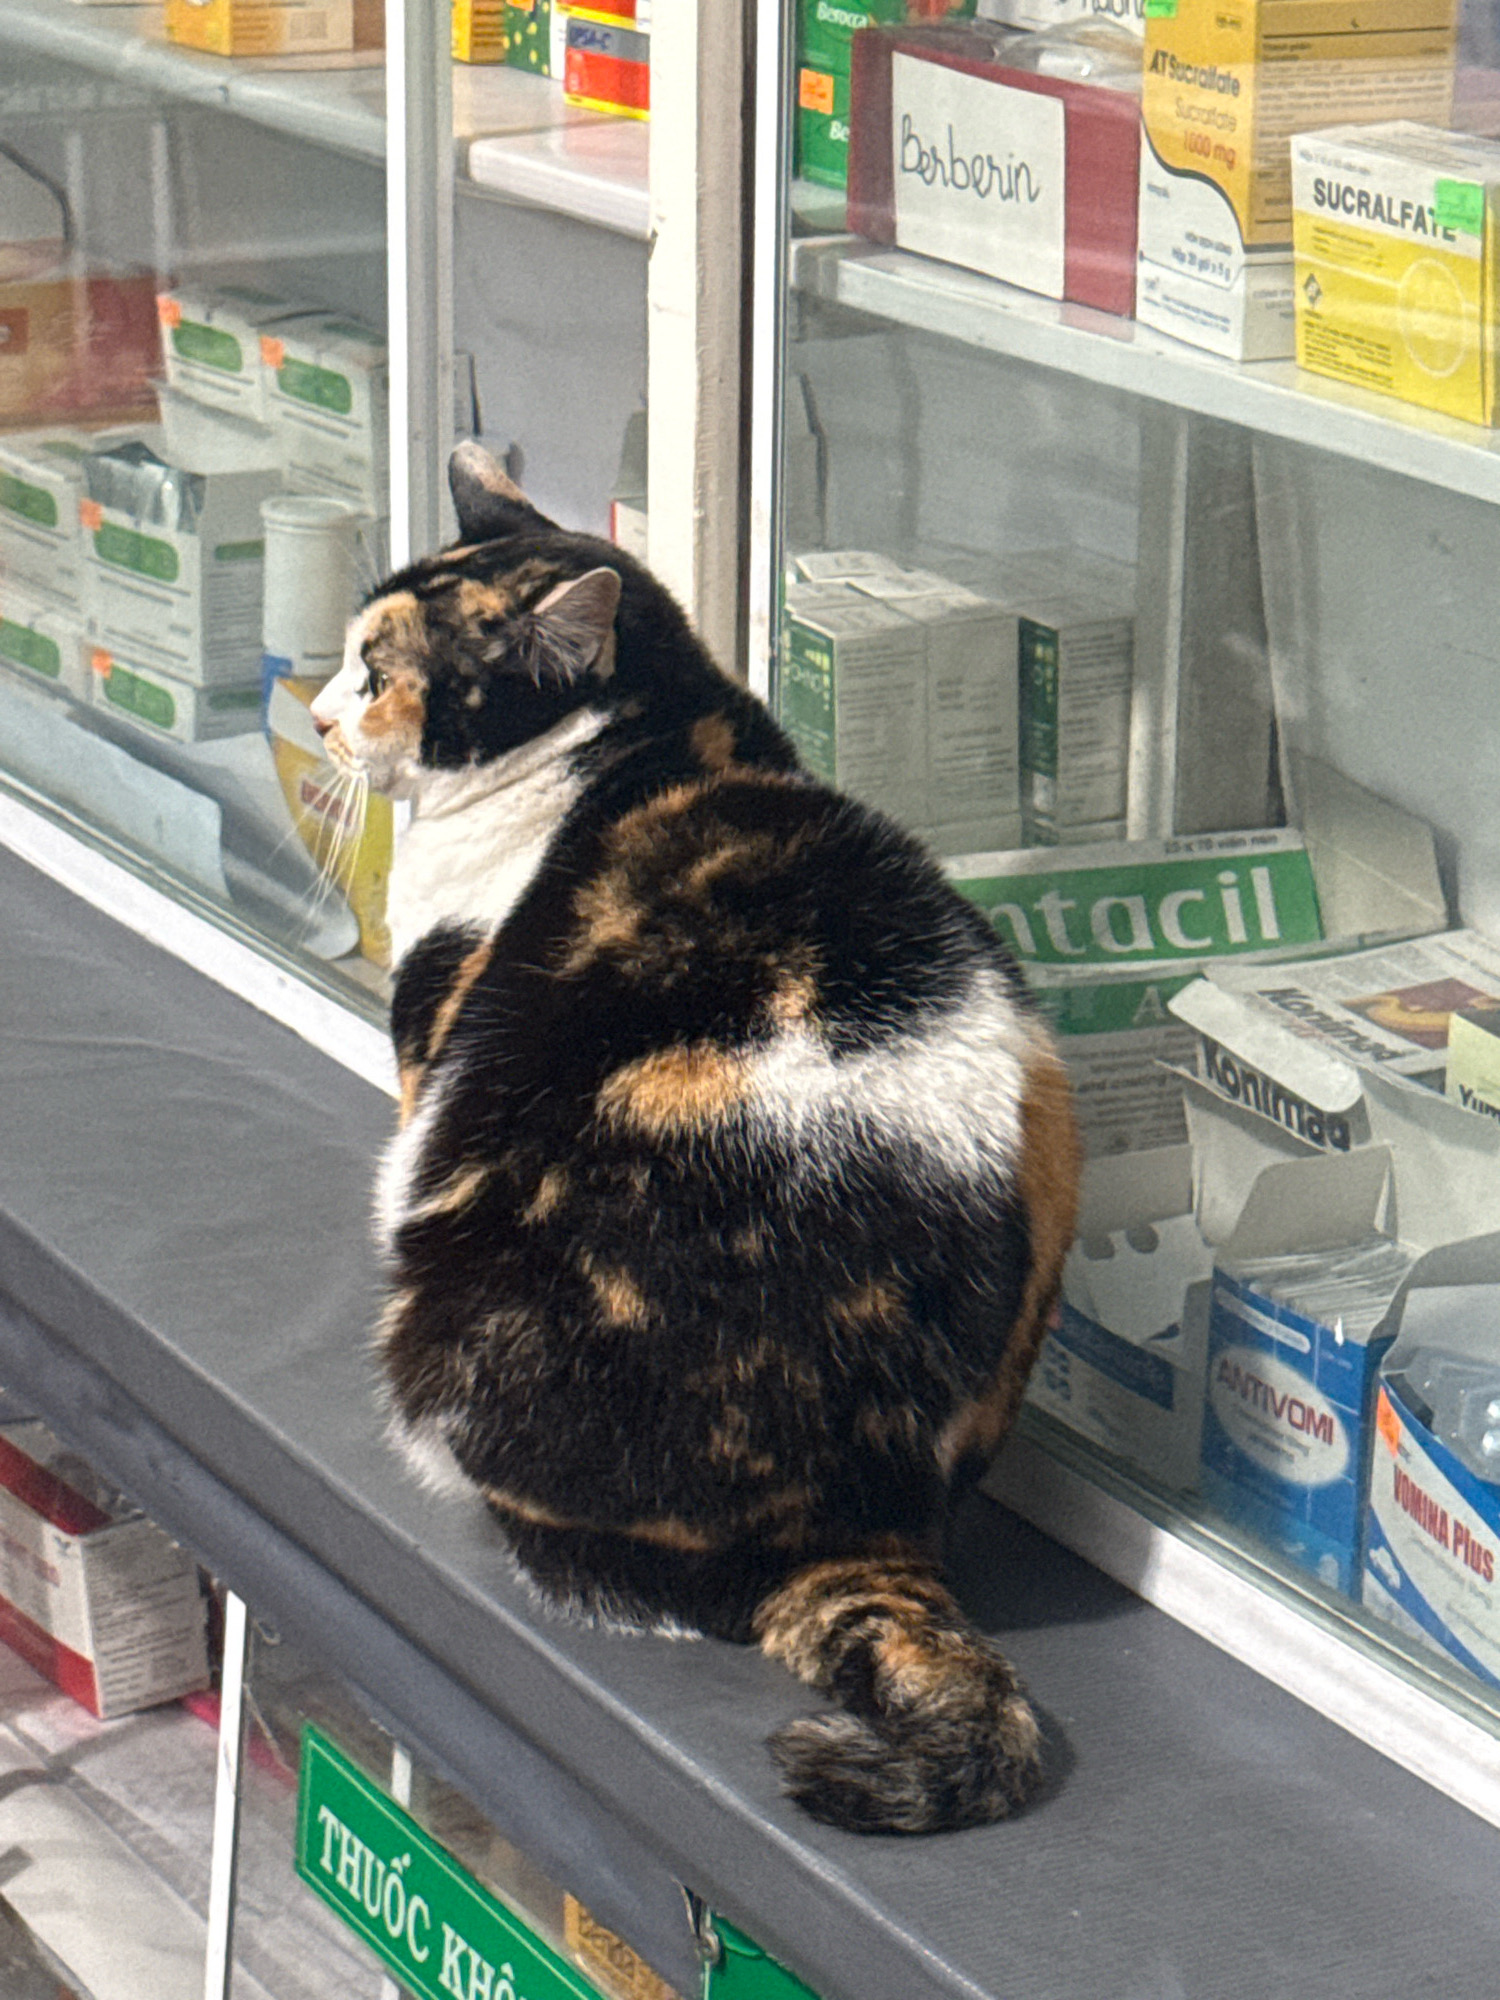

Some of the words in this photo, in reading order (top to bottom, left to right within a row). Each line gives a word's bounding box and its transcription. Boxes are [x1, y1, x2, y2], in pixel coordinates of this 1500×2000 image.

[816, 1, 868, 28] Berocca
[901, 113, 1041, 203] Berberin
[1217, 1358, 1334, 1446] ANTIVOMI
[318, 1805, 431, 1963] THUỐC
[438, 1921, 527, 2000] KHÔ
